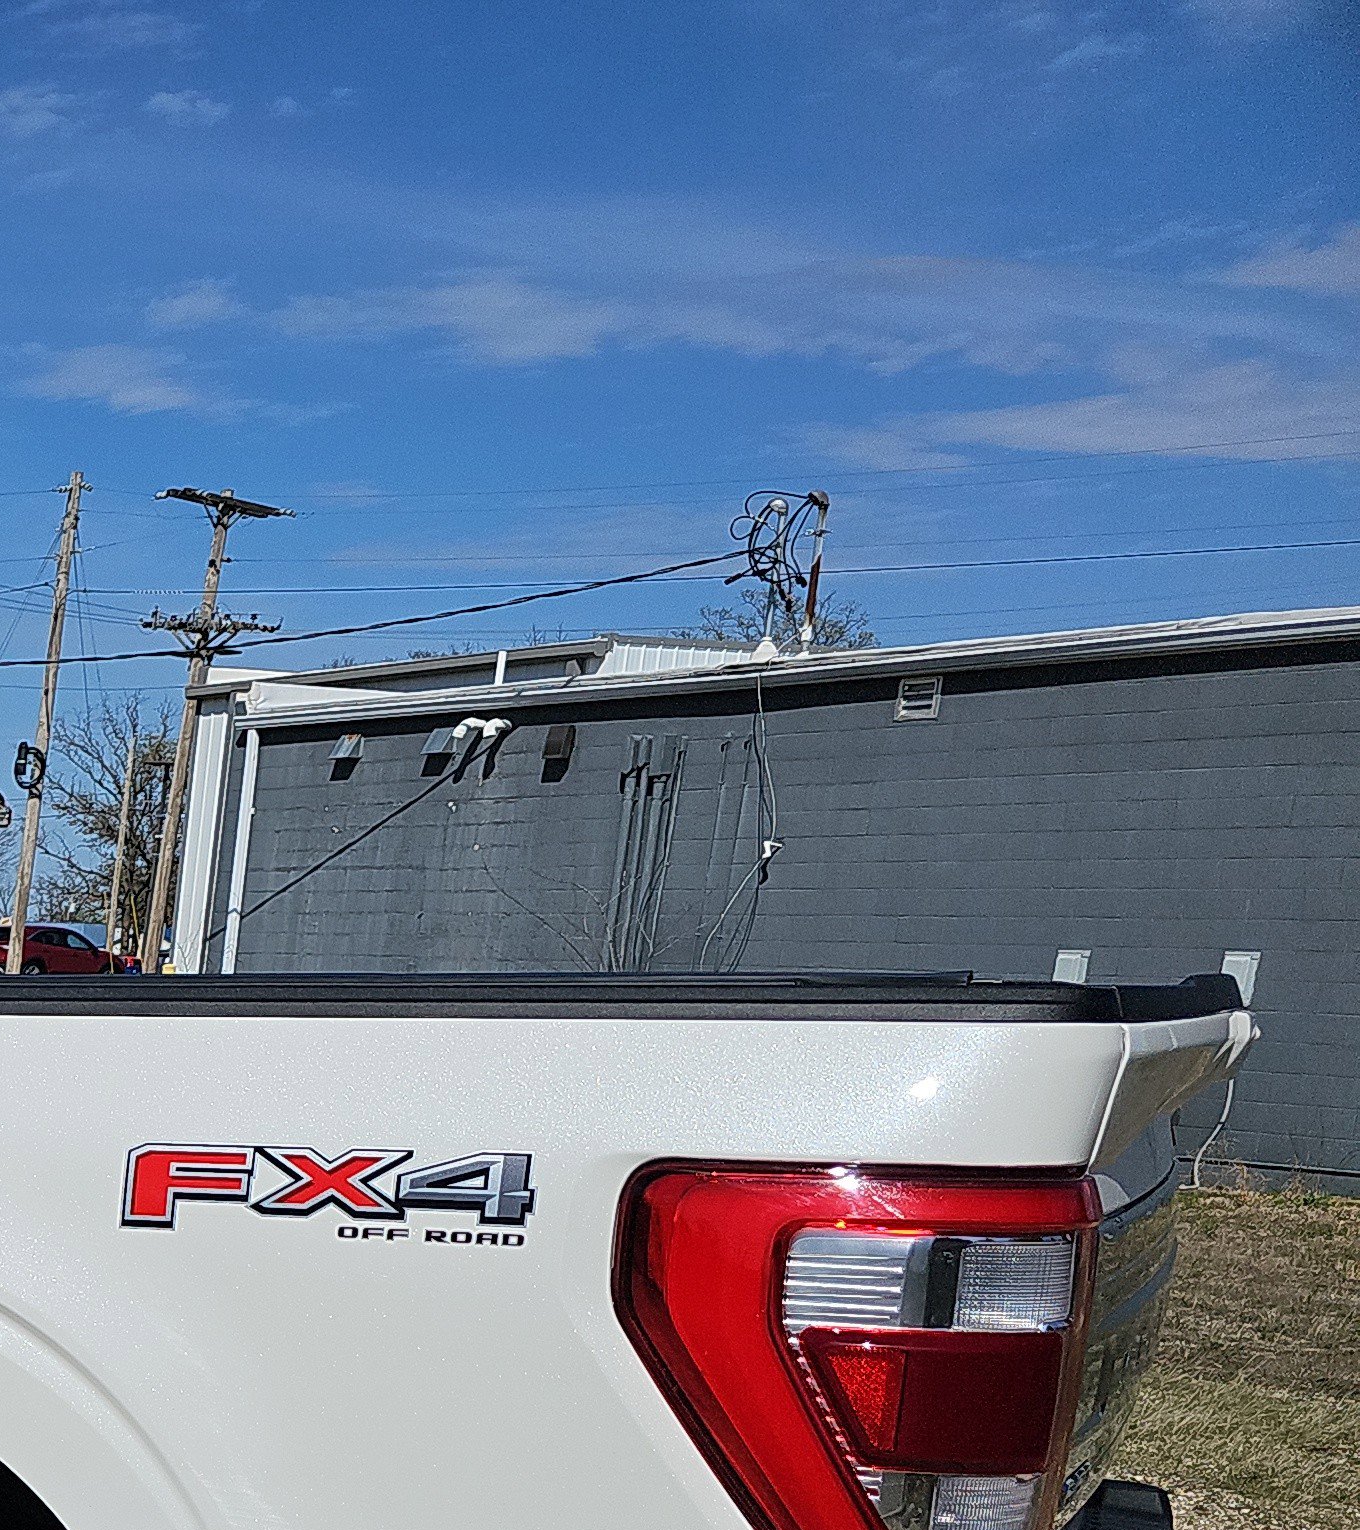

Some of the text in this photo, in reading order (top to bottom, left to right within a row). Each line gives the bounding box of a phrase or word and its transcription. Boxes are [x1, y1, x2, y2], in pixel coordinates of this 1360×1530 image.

[119, 1142, 538, 1230] FX4
[337, 1225, 526, 1247] OFF ROAD
